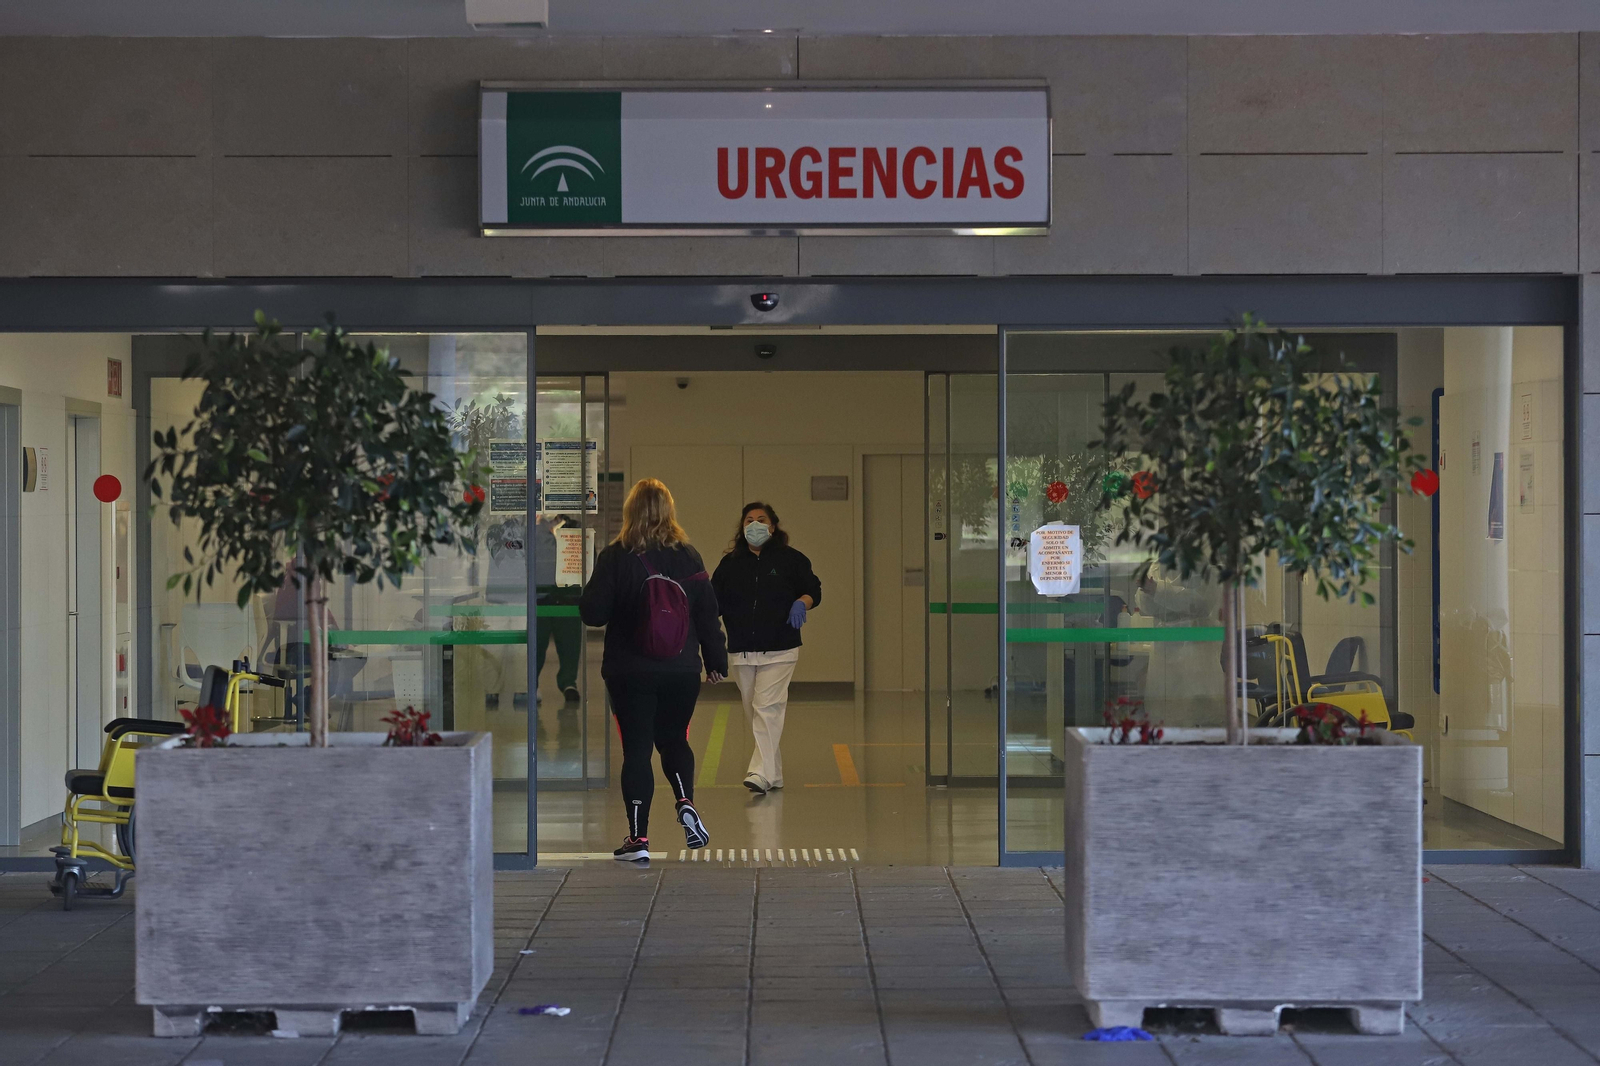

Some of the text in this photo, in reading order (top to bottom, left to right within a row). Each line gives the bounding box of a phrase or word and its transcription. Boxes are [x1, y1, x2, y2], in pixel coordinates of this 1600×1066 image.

[717, 146, 1025, 200] URGENCIAS
[520, 196, 606, 206] JUNTA DE ANDALUCIA
